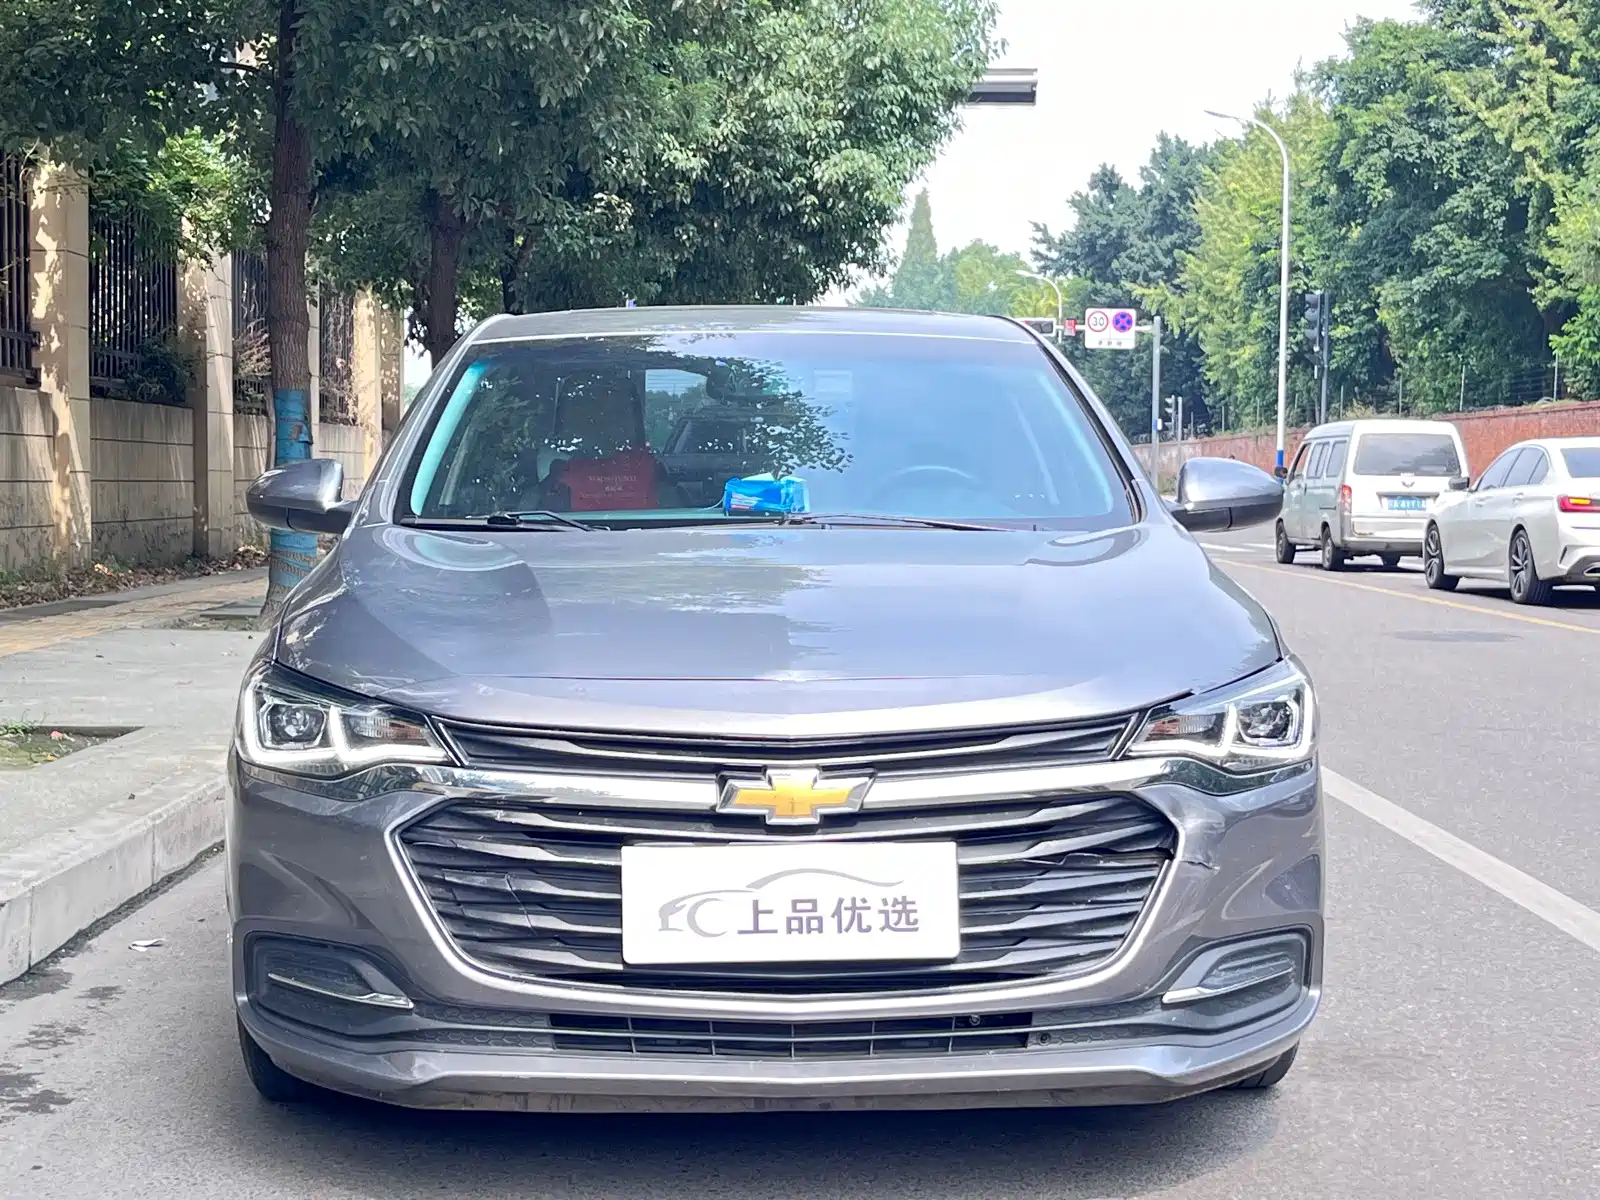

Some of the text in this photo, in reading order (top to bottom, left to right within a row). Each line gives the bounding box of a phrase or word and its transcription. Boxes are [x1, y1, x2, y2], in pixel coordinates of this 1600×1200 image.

[1092, 316, 1105, 327] 30
[737, 895, 920, 935] 上品优选
